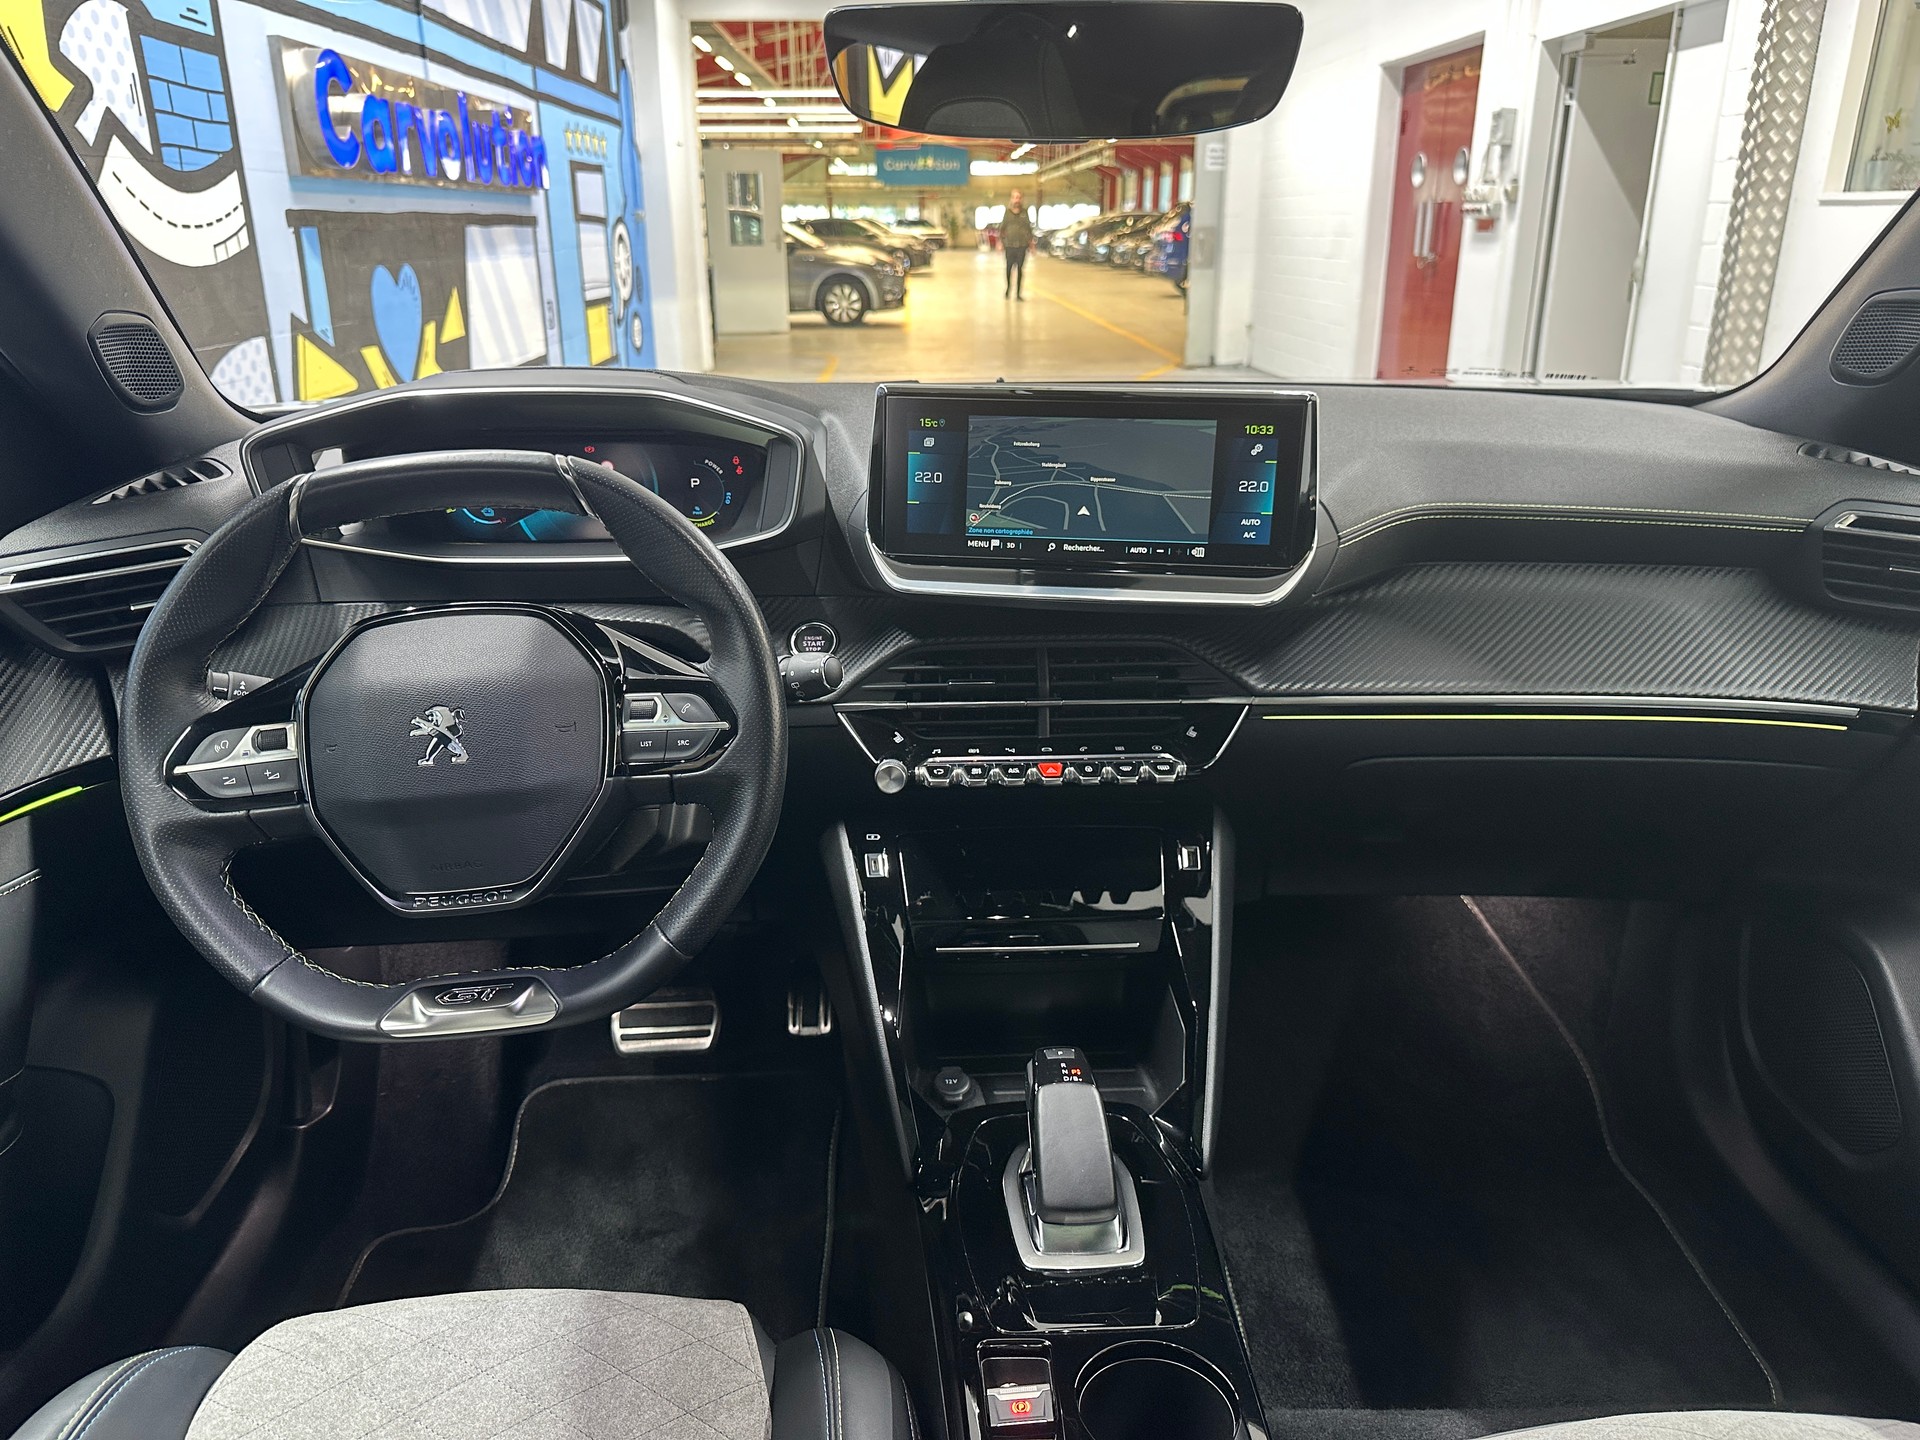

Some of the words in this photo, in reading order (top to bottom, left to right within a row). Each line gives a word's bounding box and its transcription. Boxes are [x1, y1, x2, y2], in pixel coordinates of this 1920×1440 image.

[315, 48, 550, 189] Carvolution
[883, 157, 960, 171] Carvtion
[1244, 425, 1274, 435] 10:33
[704, 459, 724, 475] POWER
[690, 478, 700, 488] P
[914, 471, 943, 483] 22.0
[1238, 480, 1270, 492] 22.0
[967, 540, 990, 548] MENU
[412, 889, 513, 908] PEUGEOT
